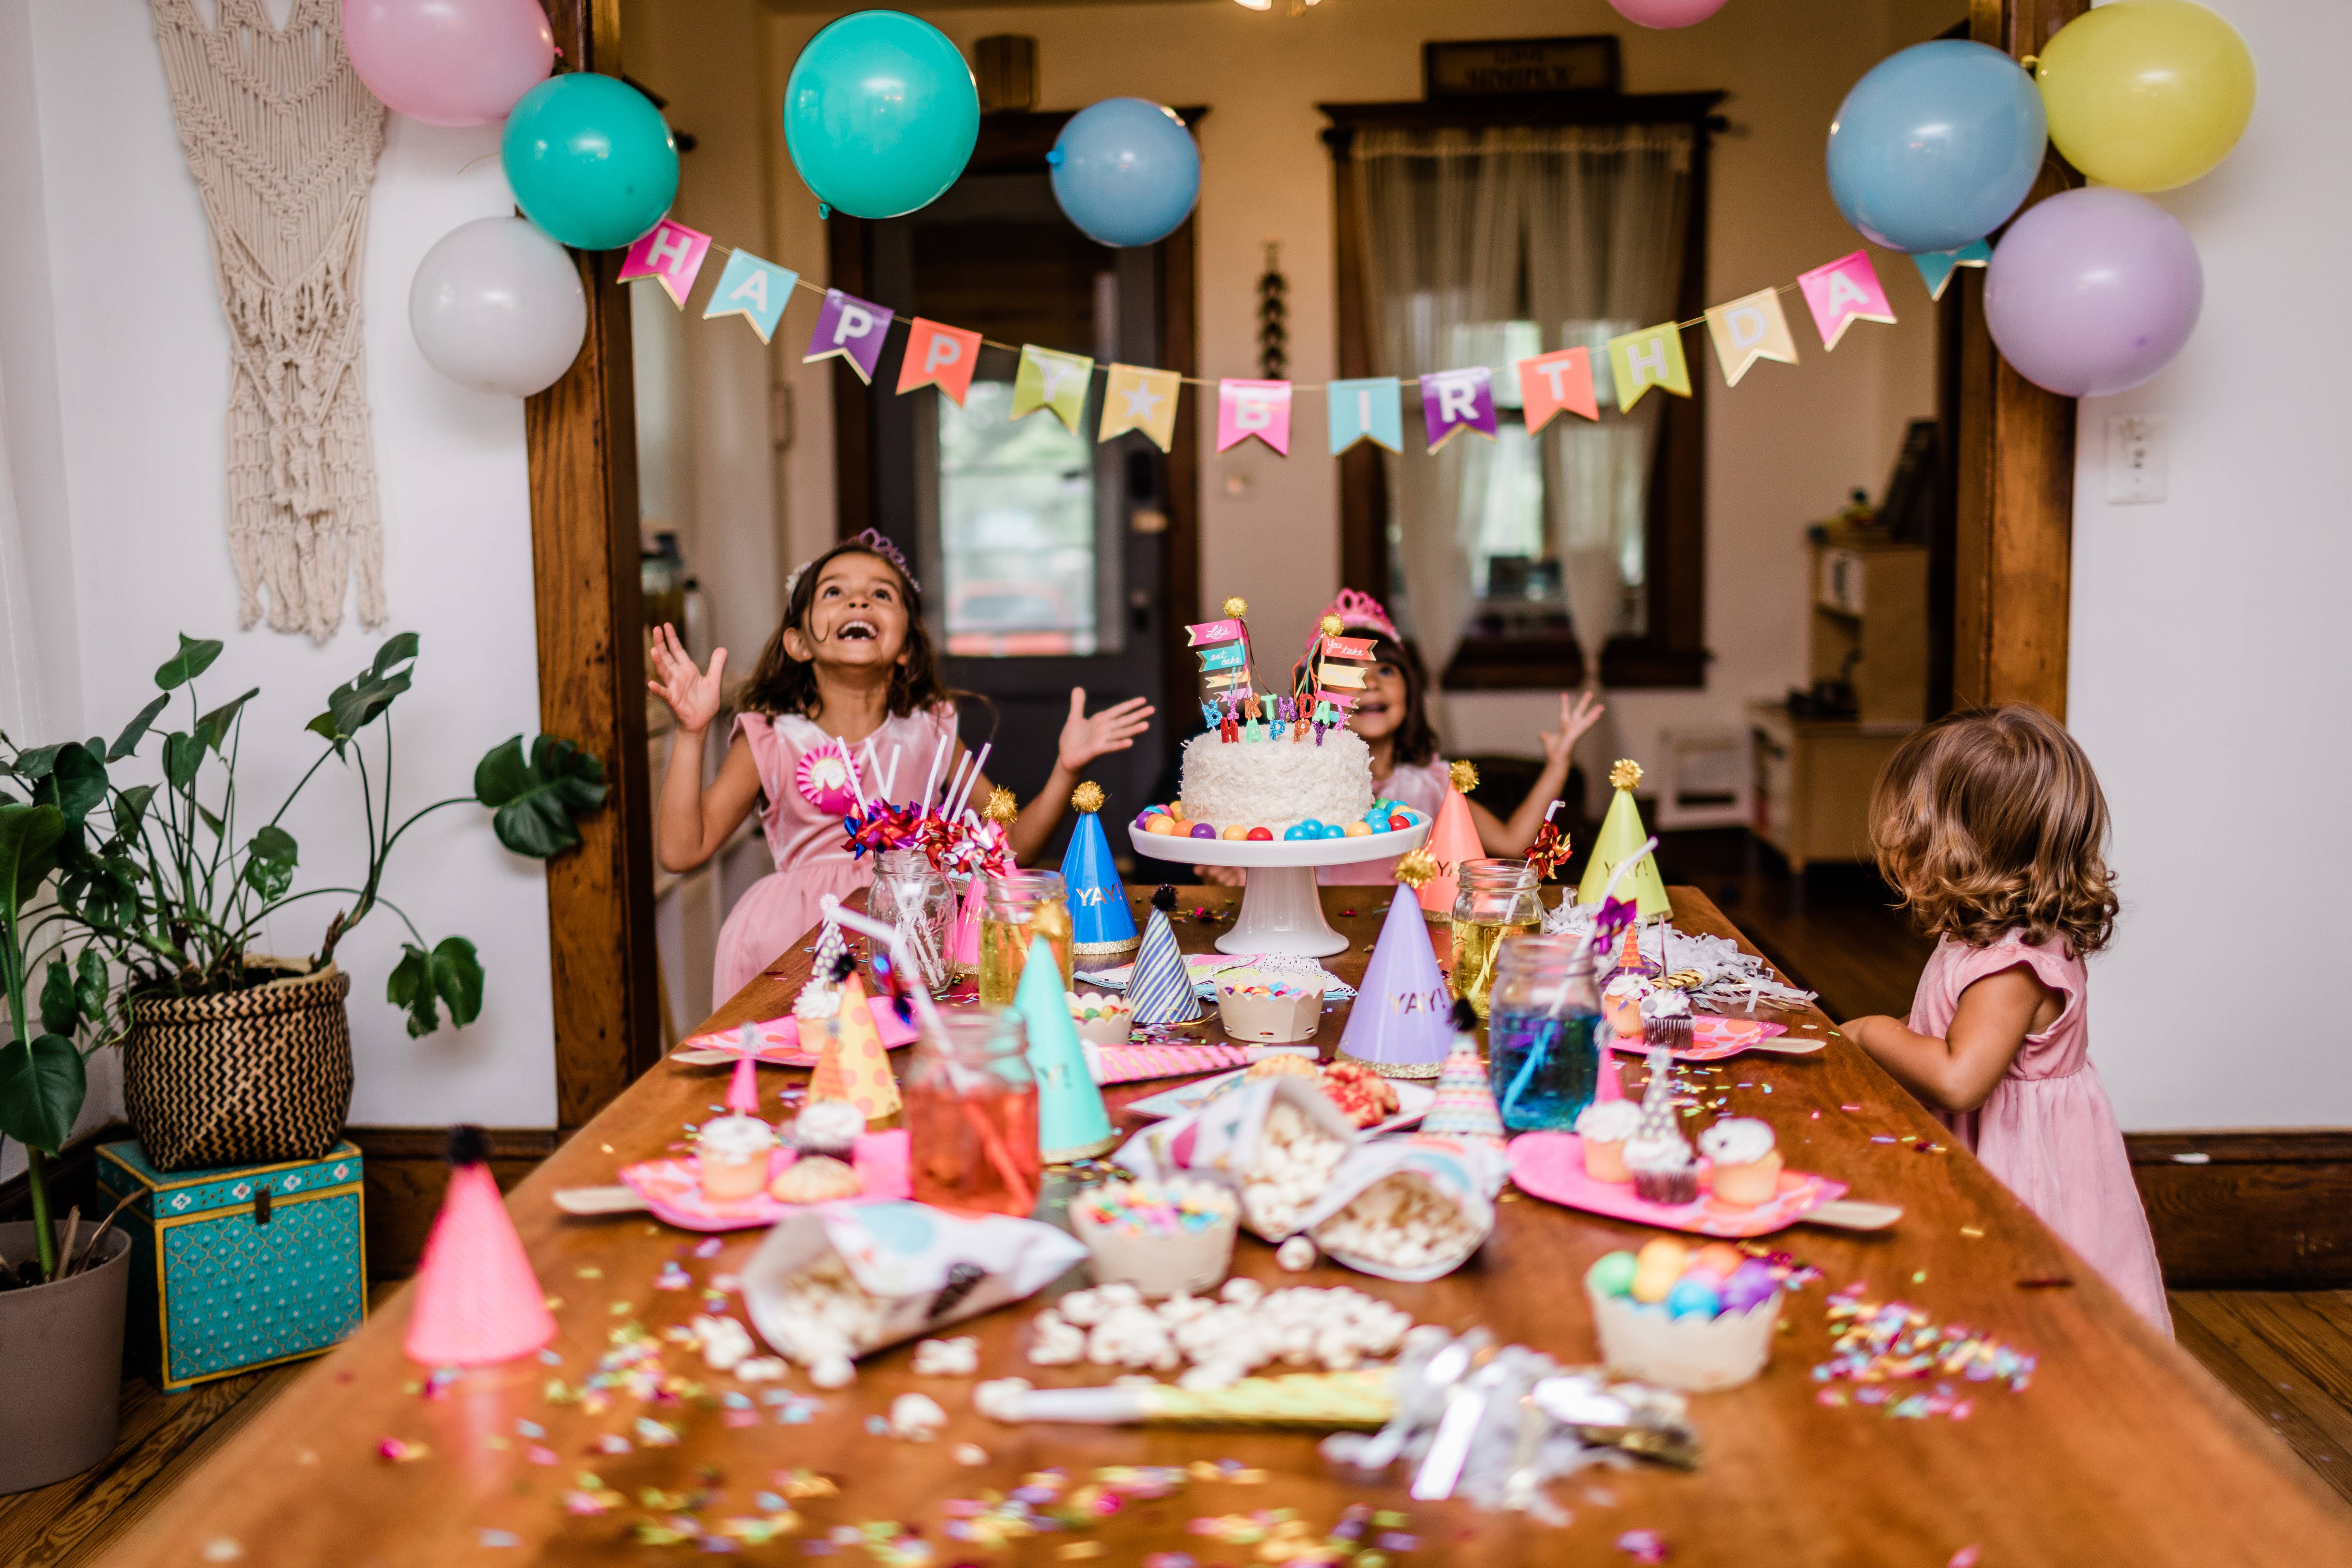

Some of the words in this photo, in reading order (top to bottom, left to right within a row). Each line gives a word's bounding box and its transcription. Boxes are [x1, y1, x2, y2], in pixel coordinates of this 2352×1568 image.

[645, 227, 1073, 402] HAPPY
[1235, 271, 1870, 430] BIRTHDA
[1206, 625, 1231, 639] Let's
[1209, 650, 1227, 660] eat
[1221, 656, 1242, 665] cake
[1327, 638, 1342, 653] You
[1340, 646, 1364, 656] take
[1202, 692, 1347, 731] BIRTHDAY
[1220, 717, 1328, 747] HAPPY
[1076, 883, 1122, 906] YAY!
[1389, 988, 1445, 1015] YAY!
